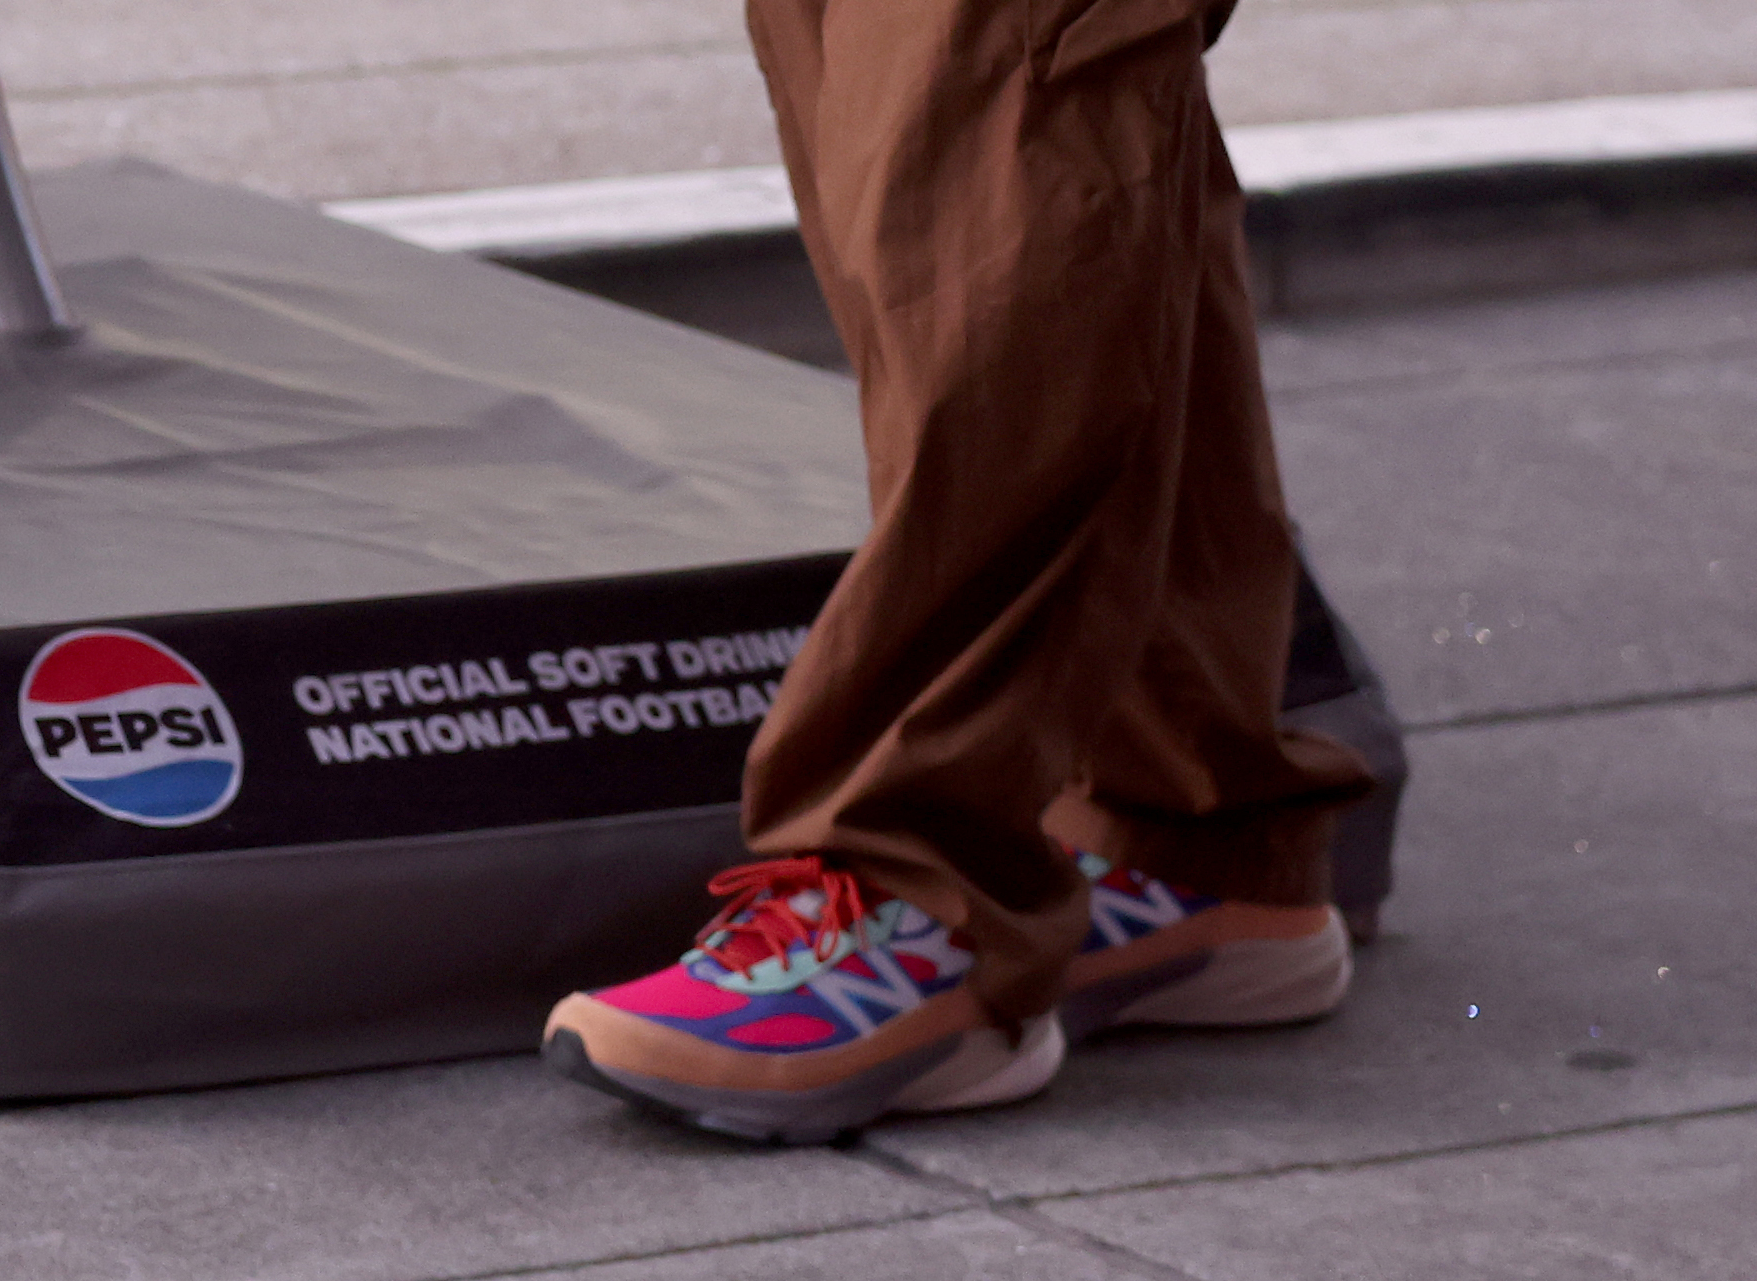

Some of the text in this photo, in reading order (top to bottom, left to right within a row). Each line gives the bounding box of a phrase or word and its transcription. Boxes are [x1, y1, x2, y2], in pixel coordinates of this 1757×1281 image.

[293, 657, 529, 717] OFFICIAL
[527, 641, 660, 692] SOFT
[34, 704, 227, 759] PEPSI
[305, 679, 780, 765] NATIONAL FOOTBA
